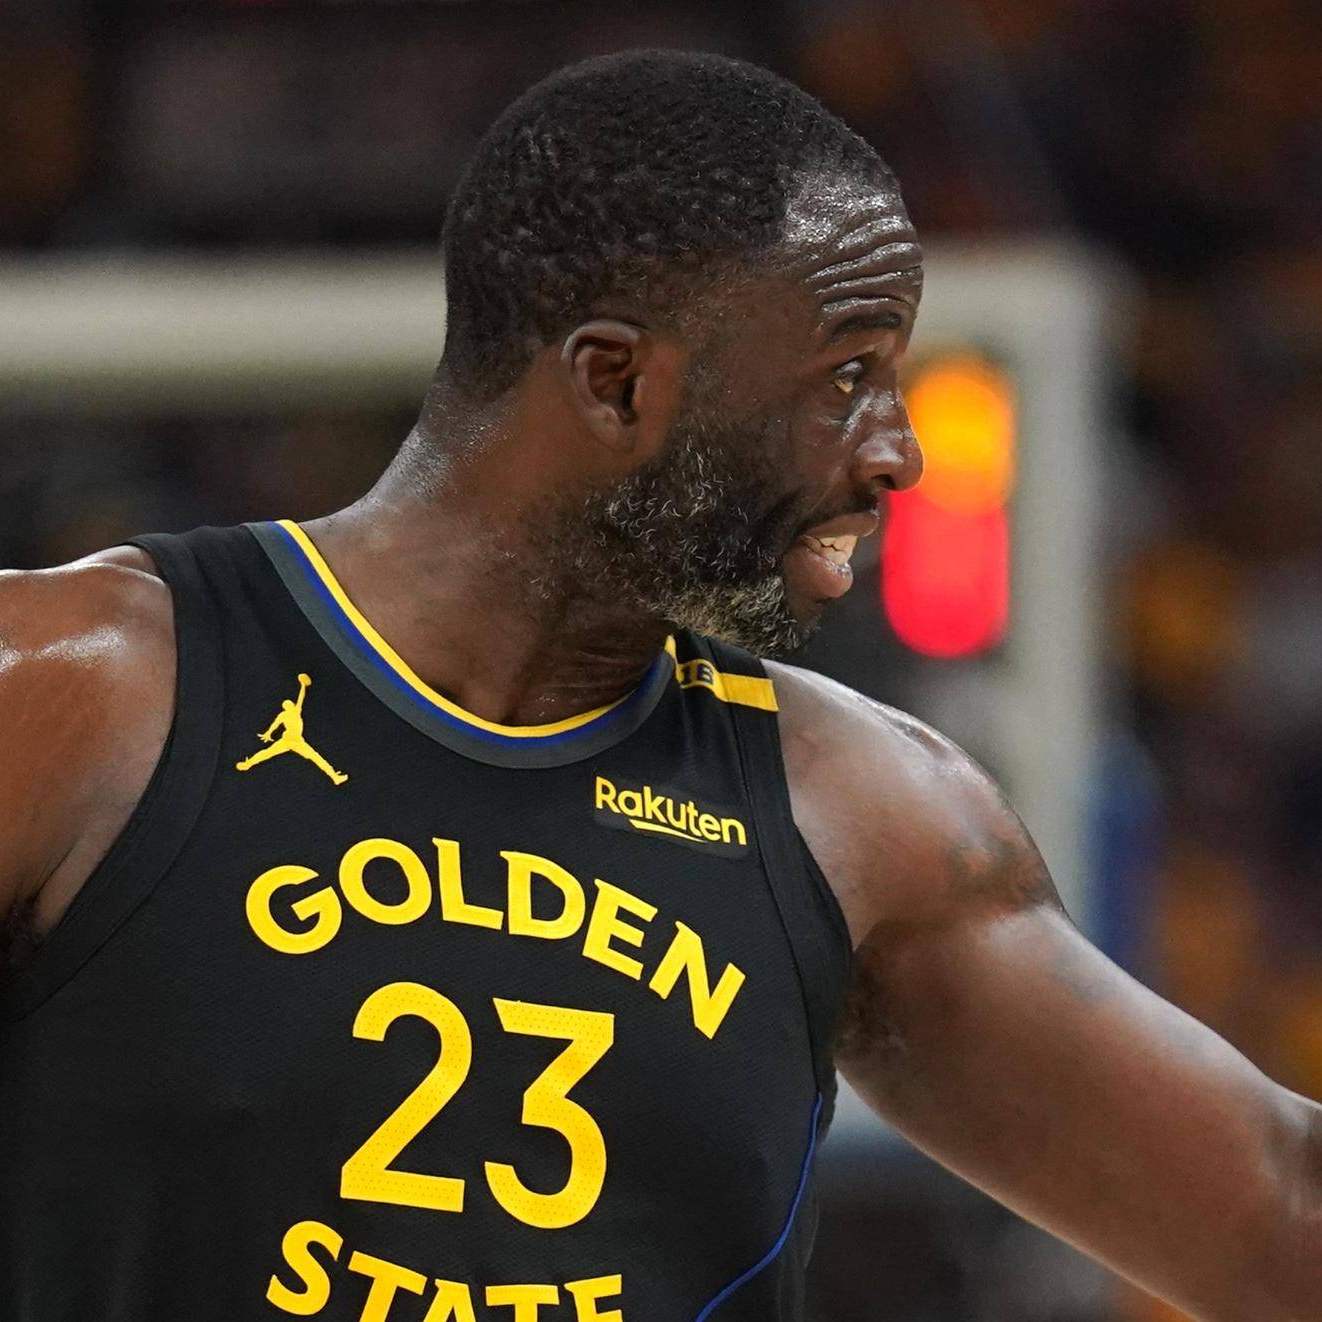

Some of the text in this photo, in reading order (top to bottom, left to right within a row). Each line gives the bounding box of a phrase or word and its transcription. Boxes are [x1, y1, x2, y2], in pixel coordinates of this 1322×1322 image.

[595, 776, 747, 845] Rakuten
[245, 837, 746, 1040] GOLDEN
[340, 981, 615, 1229] 23
